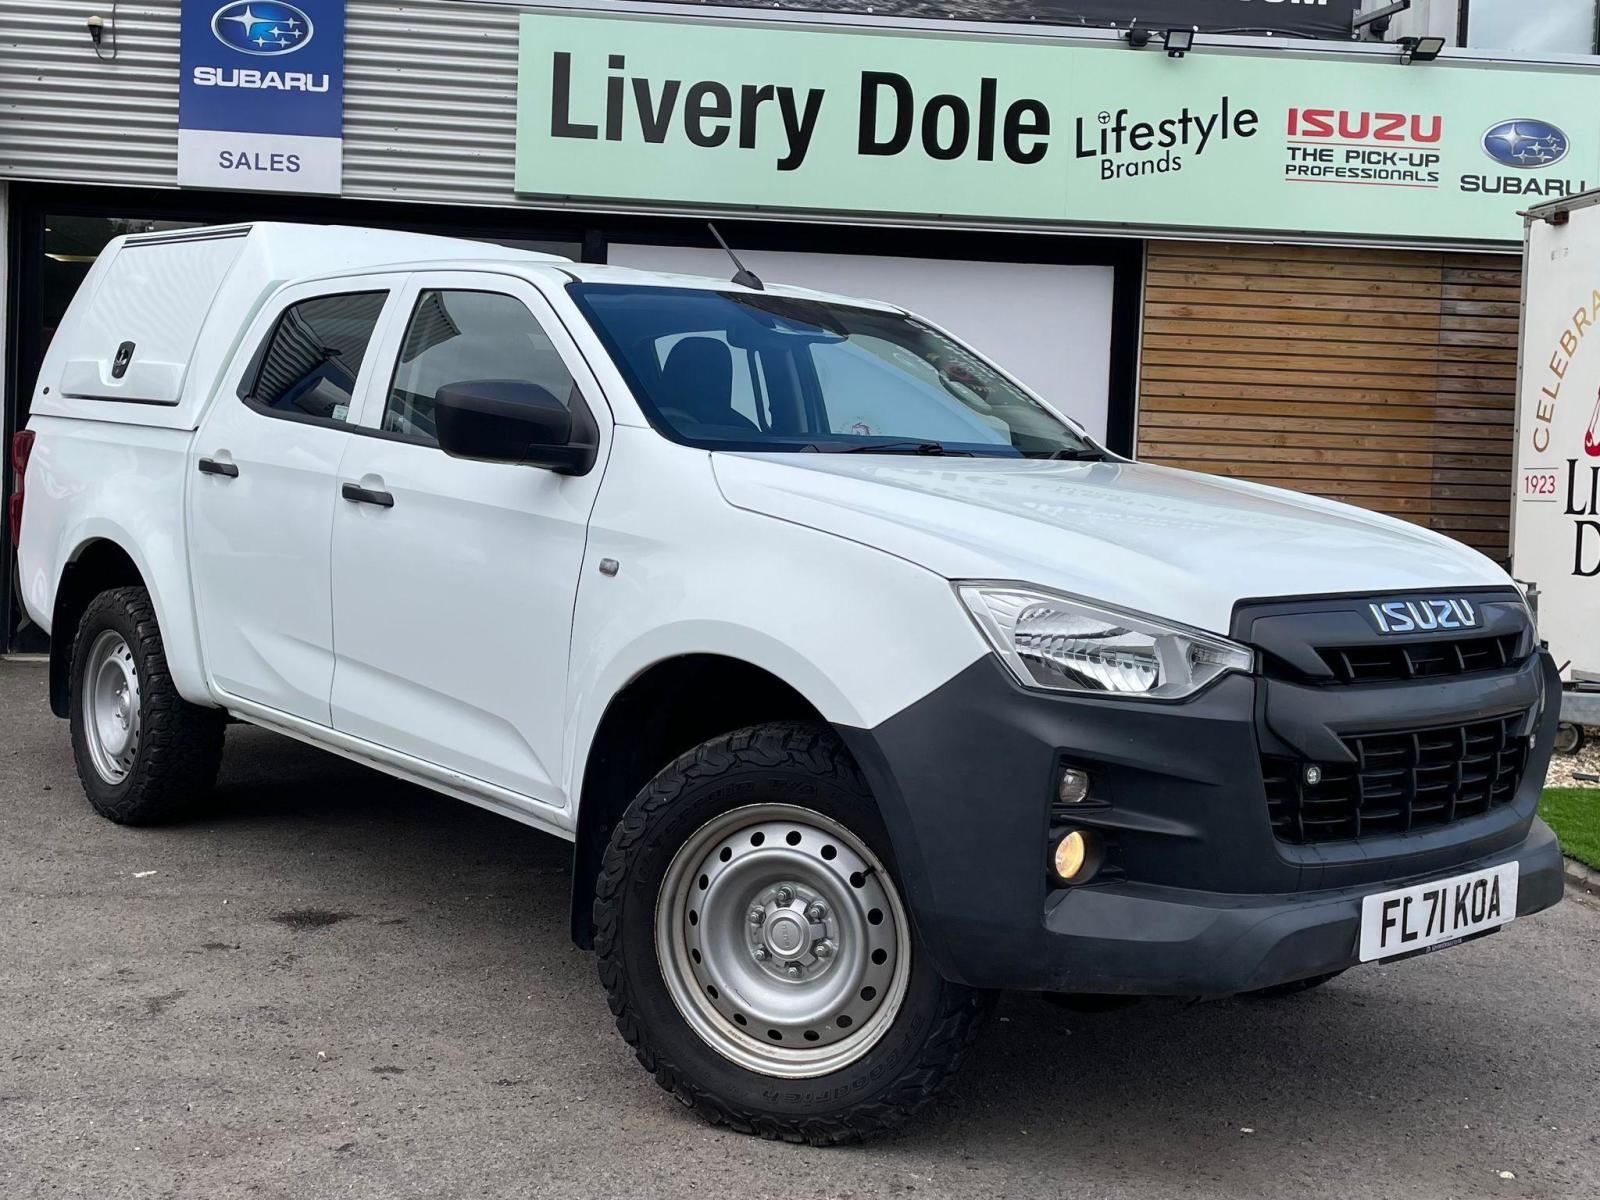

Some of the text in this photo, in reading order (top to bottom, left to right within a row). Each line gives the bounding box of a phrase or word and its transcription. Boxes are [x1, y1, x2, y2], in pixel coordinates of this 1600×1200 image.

[193, 66, 329, 92] SUBARU
[551, 51, 1050, 171] Livery Dole
[1075, 95, 1259, 159] Lifestyle
[1287, 108, 1442, 143] ISUZU
[218, 149, 301, 174] SALES
[1101, 149, 1182, 180] Brands
[1287, 146, 1440, 168] THE PICK-UP
[1285, 164, 1439, 182] PROFESSIONALS
[1460, 174, 1586, 197] SUBARU
[1525, 475, 1556, 494] 1923
[1369, 599, 1476, 632] ISUZU
